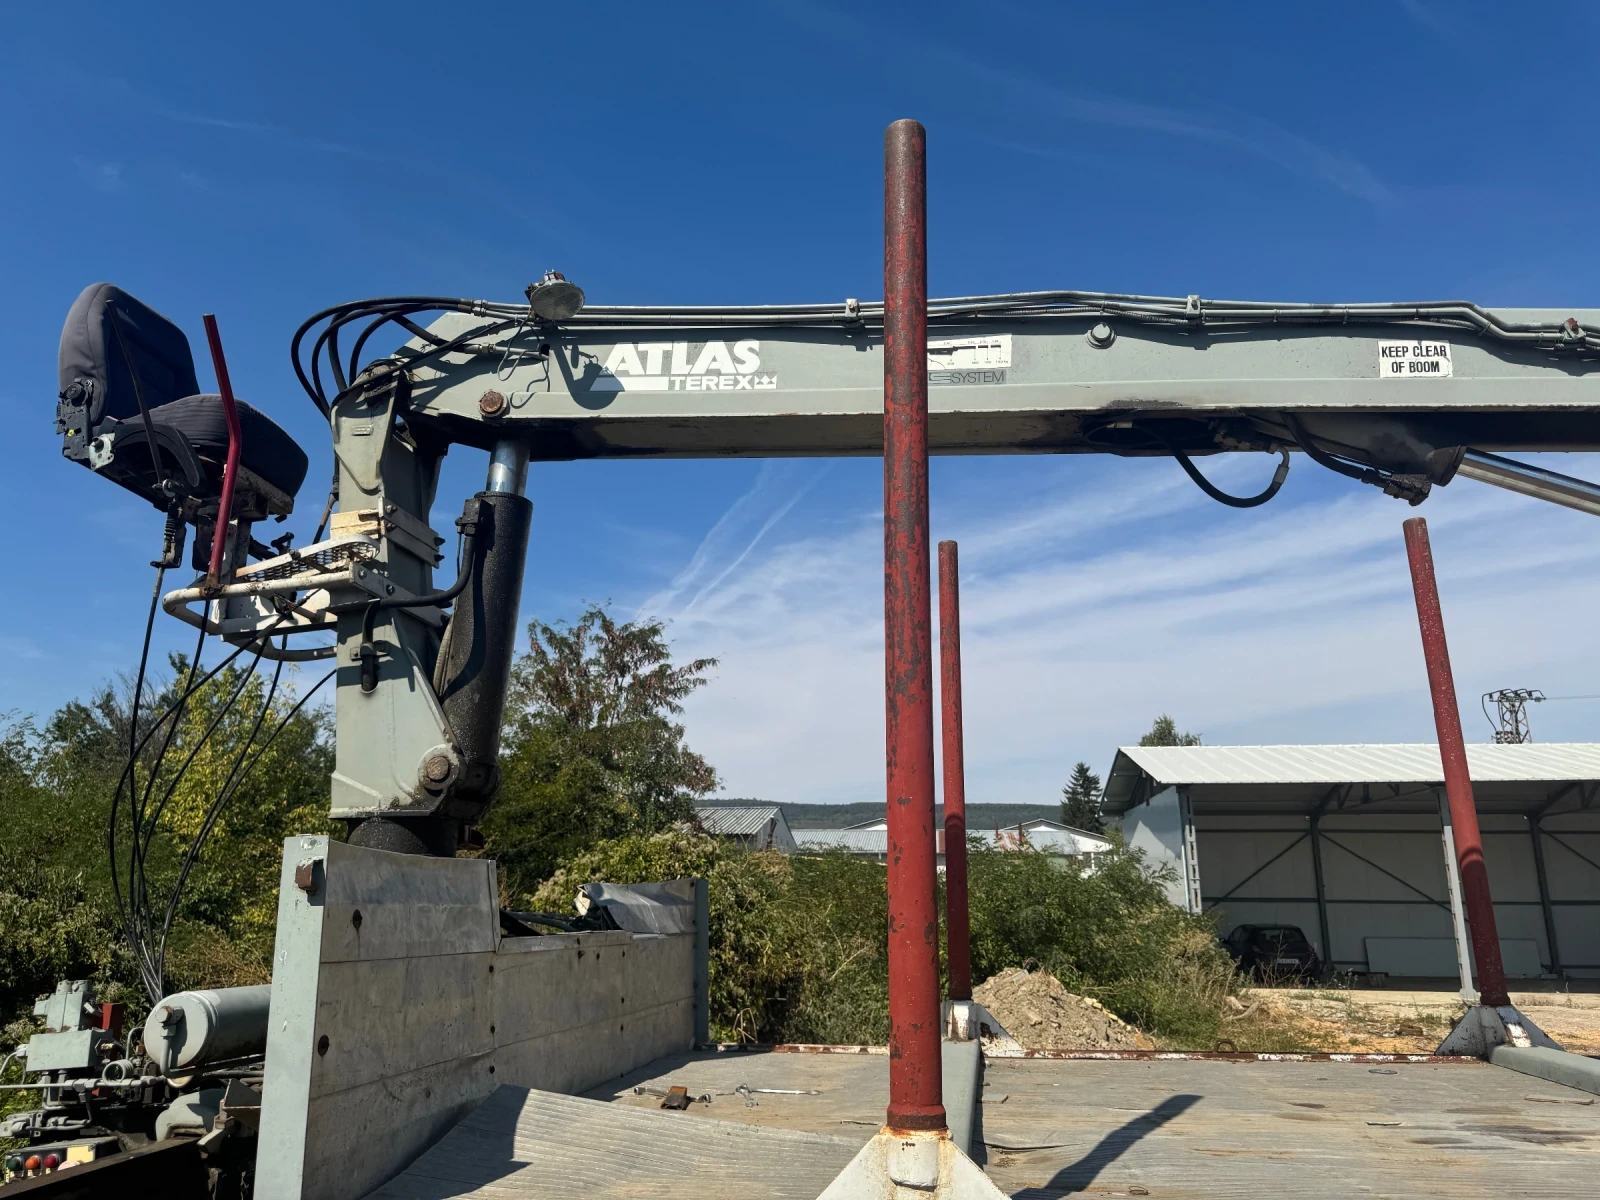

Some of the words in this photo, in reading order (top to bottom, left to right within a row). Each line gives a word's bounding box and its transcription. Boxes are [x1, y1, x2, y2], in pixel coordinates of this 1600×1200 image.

[600, 339, 761, 376] ATLAS
[1381, 346, 1409, 358] KEEP
[1412, 345, 1447, 357] CLEAR
[1391, 361, 1405, 373] OF
[1409, 361, 1440, 373] BOOM
[669, 375, 754, 391] TEREX
